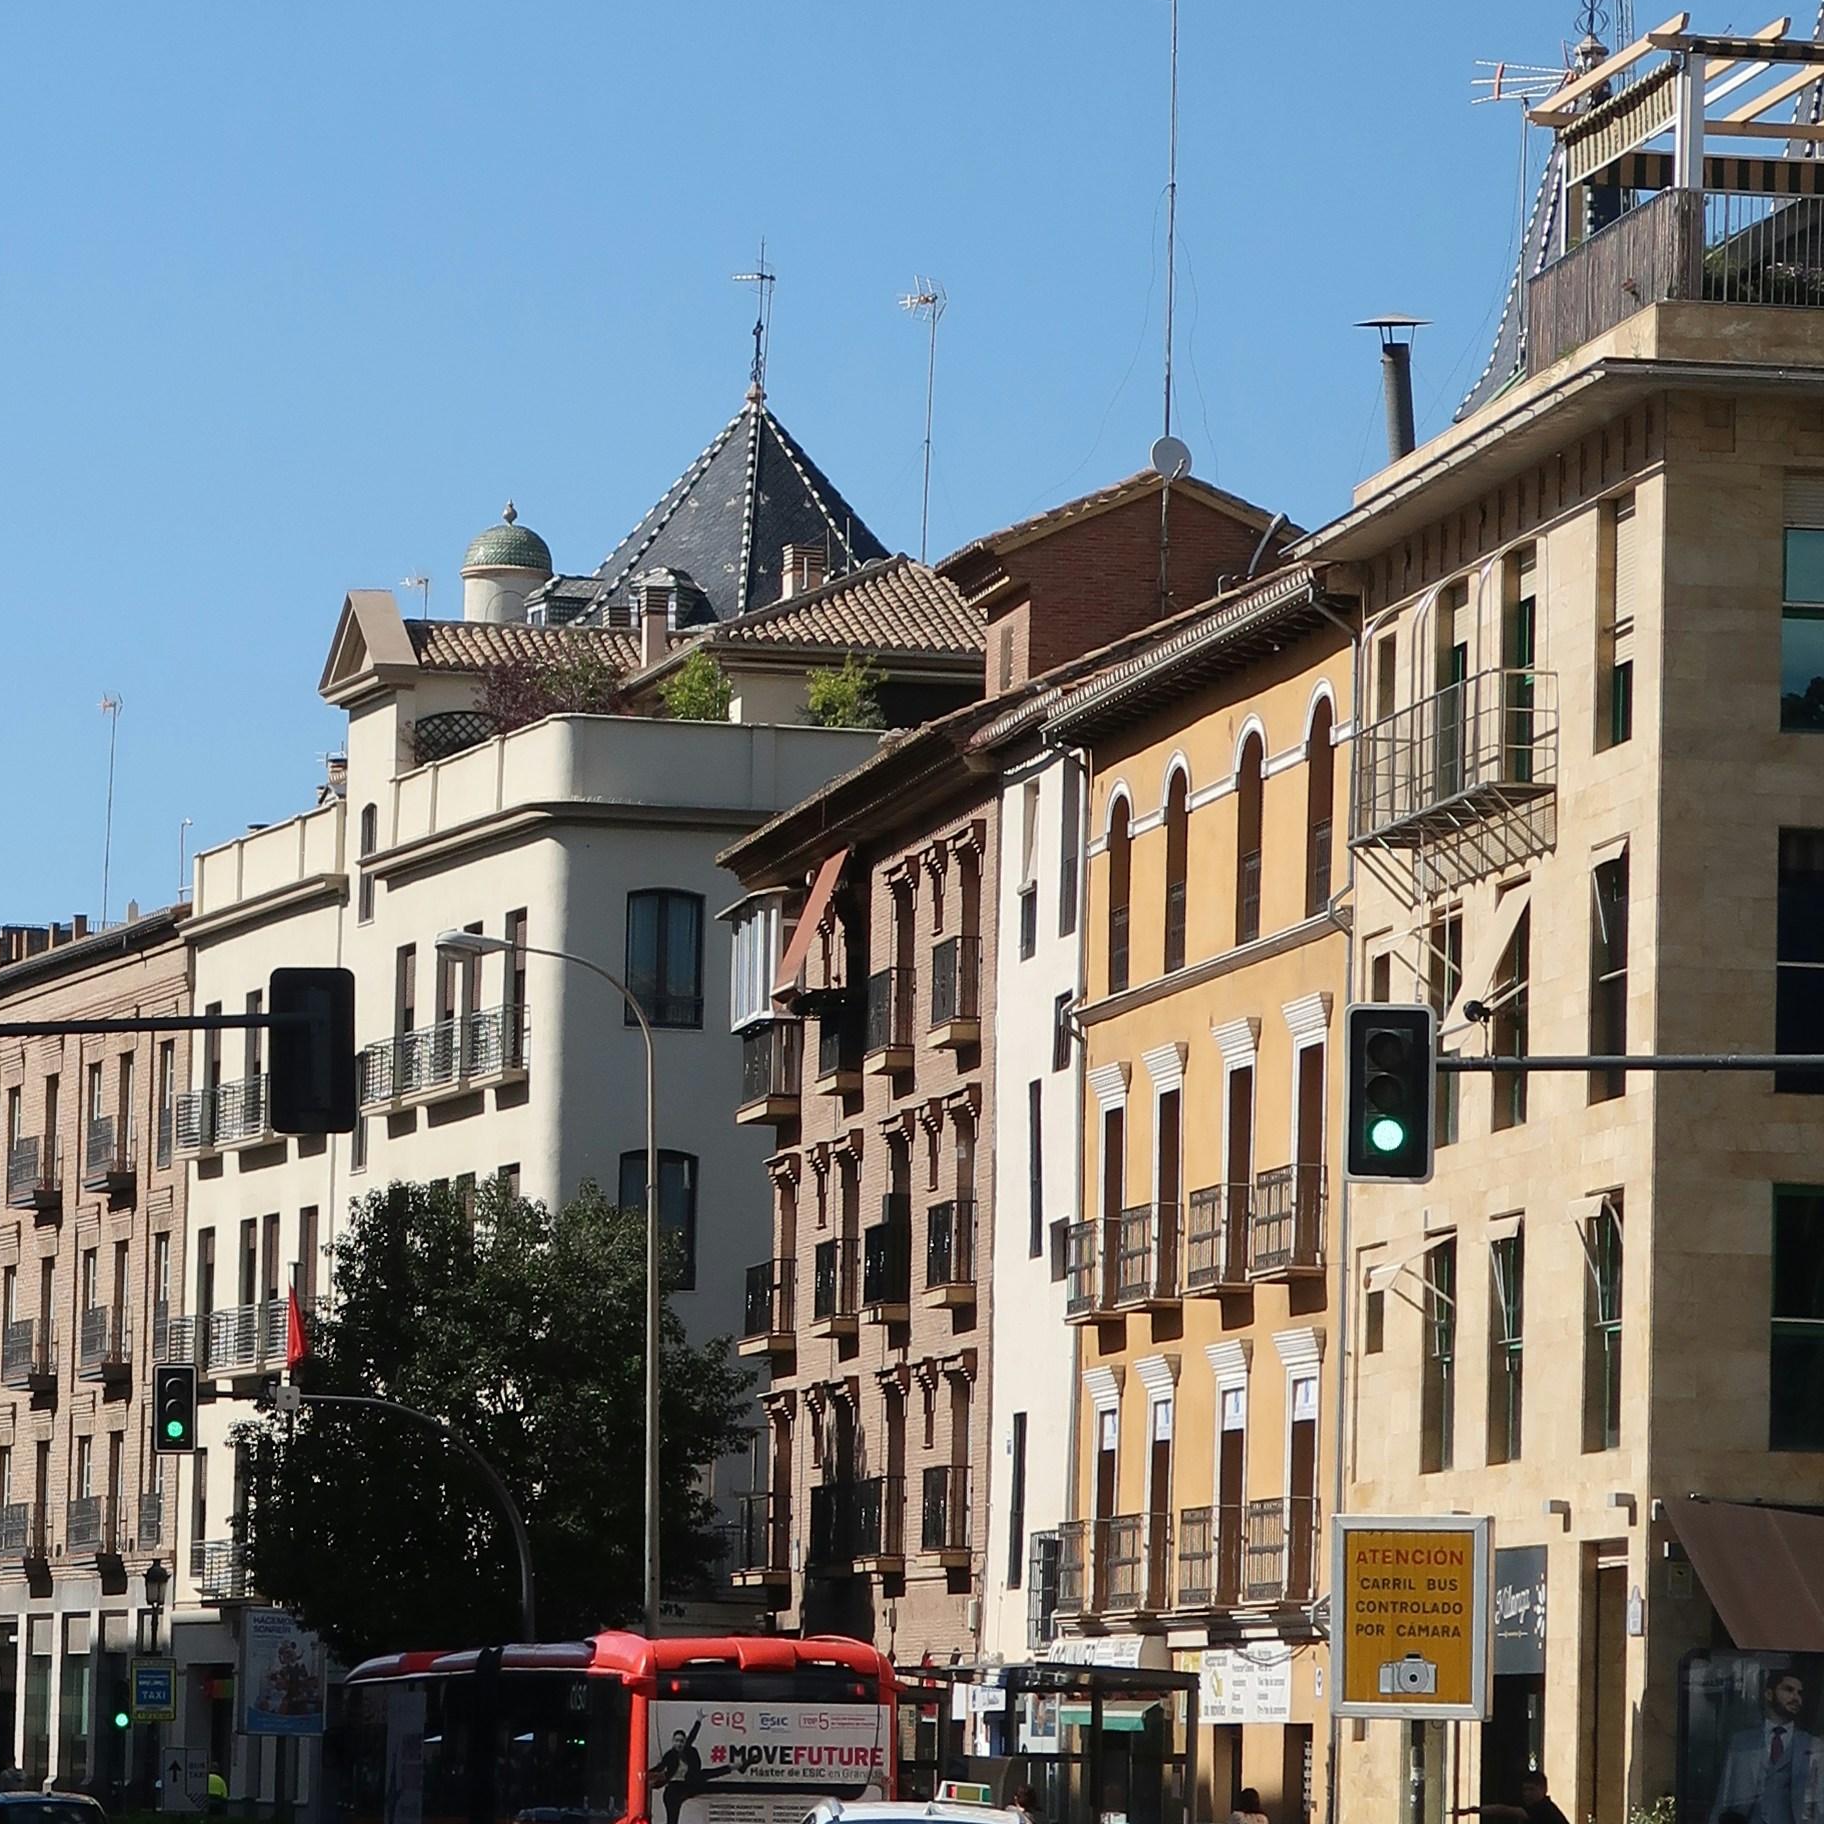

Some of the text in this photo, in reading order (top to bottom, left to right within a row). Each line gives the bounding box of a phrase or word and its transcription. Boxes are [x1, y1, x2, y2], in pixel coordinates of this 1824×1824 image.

[1355, 1546, 1464, 1566] ATENCIÓN
[1360, 1578, 1458, 1591] CARRIL BUS
[1355, 1601, 1463, 1615] CONTROLADO
[1355, 1622, 1461, 1638] POR CÁMARA
[141, 1690, 166, 1701] TAXI
[711, 1711, 747, 1734] eig
[818, 1712, 830, 1731] 5
[710, 1744, 885, 1767] #MOVEFUTURE
[188, 1762, 206, 1770] BUS
[188, 1770, 206, 1778] TAXI
[788, 1768, 801, 1778] de
[828, 1770, 841, 1779] en
